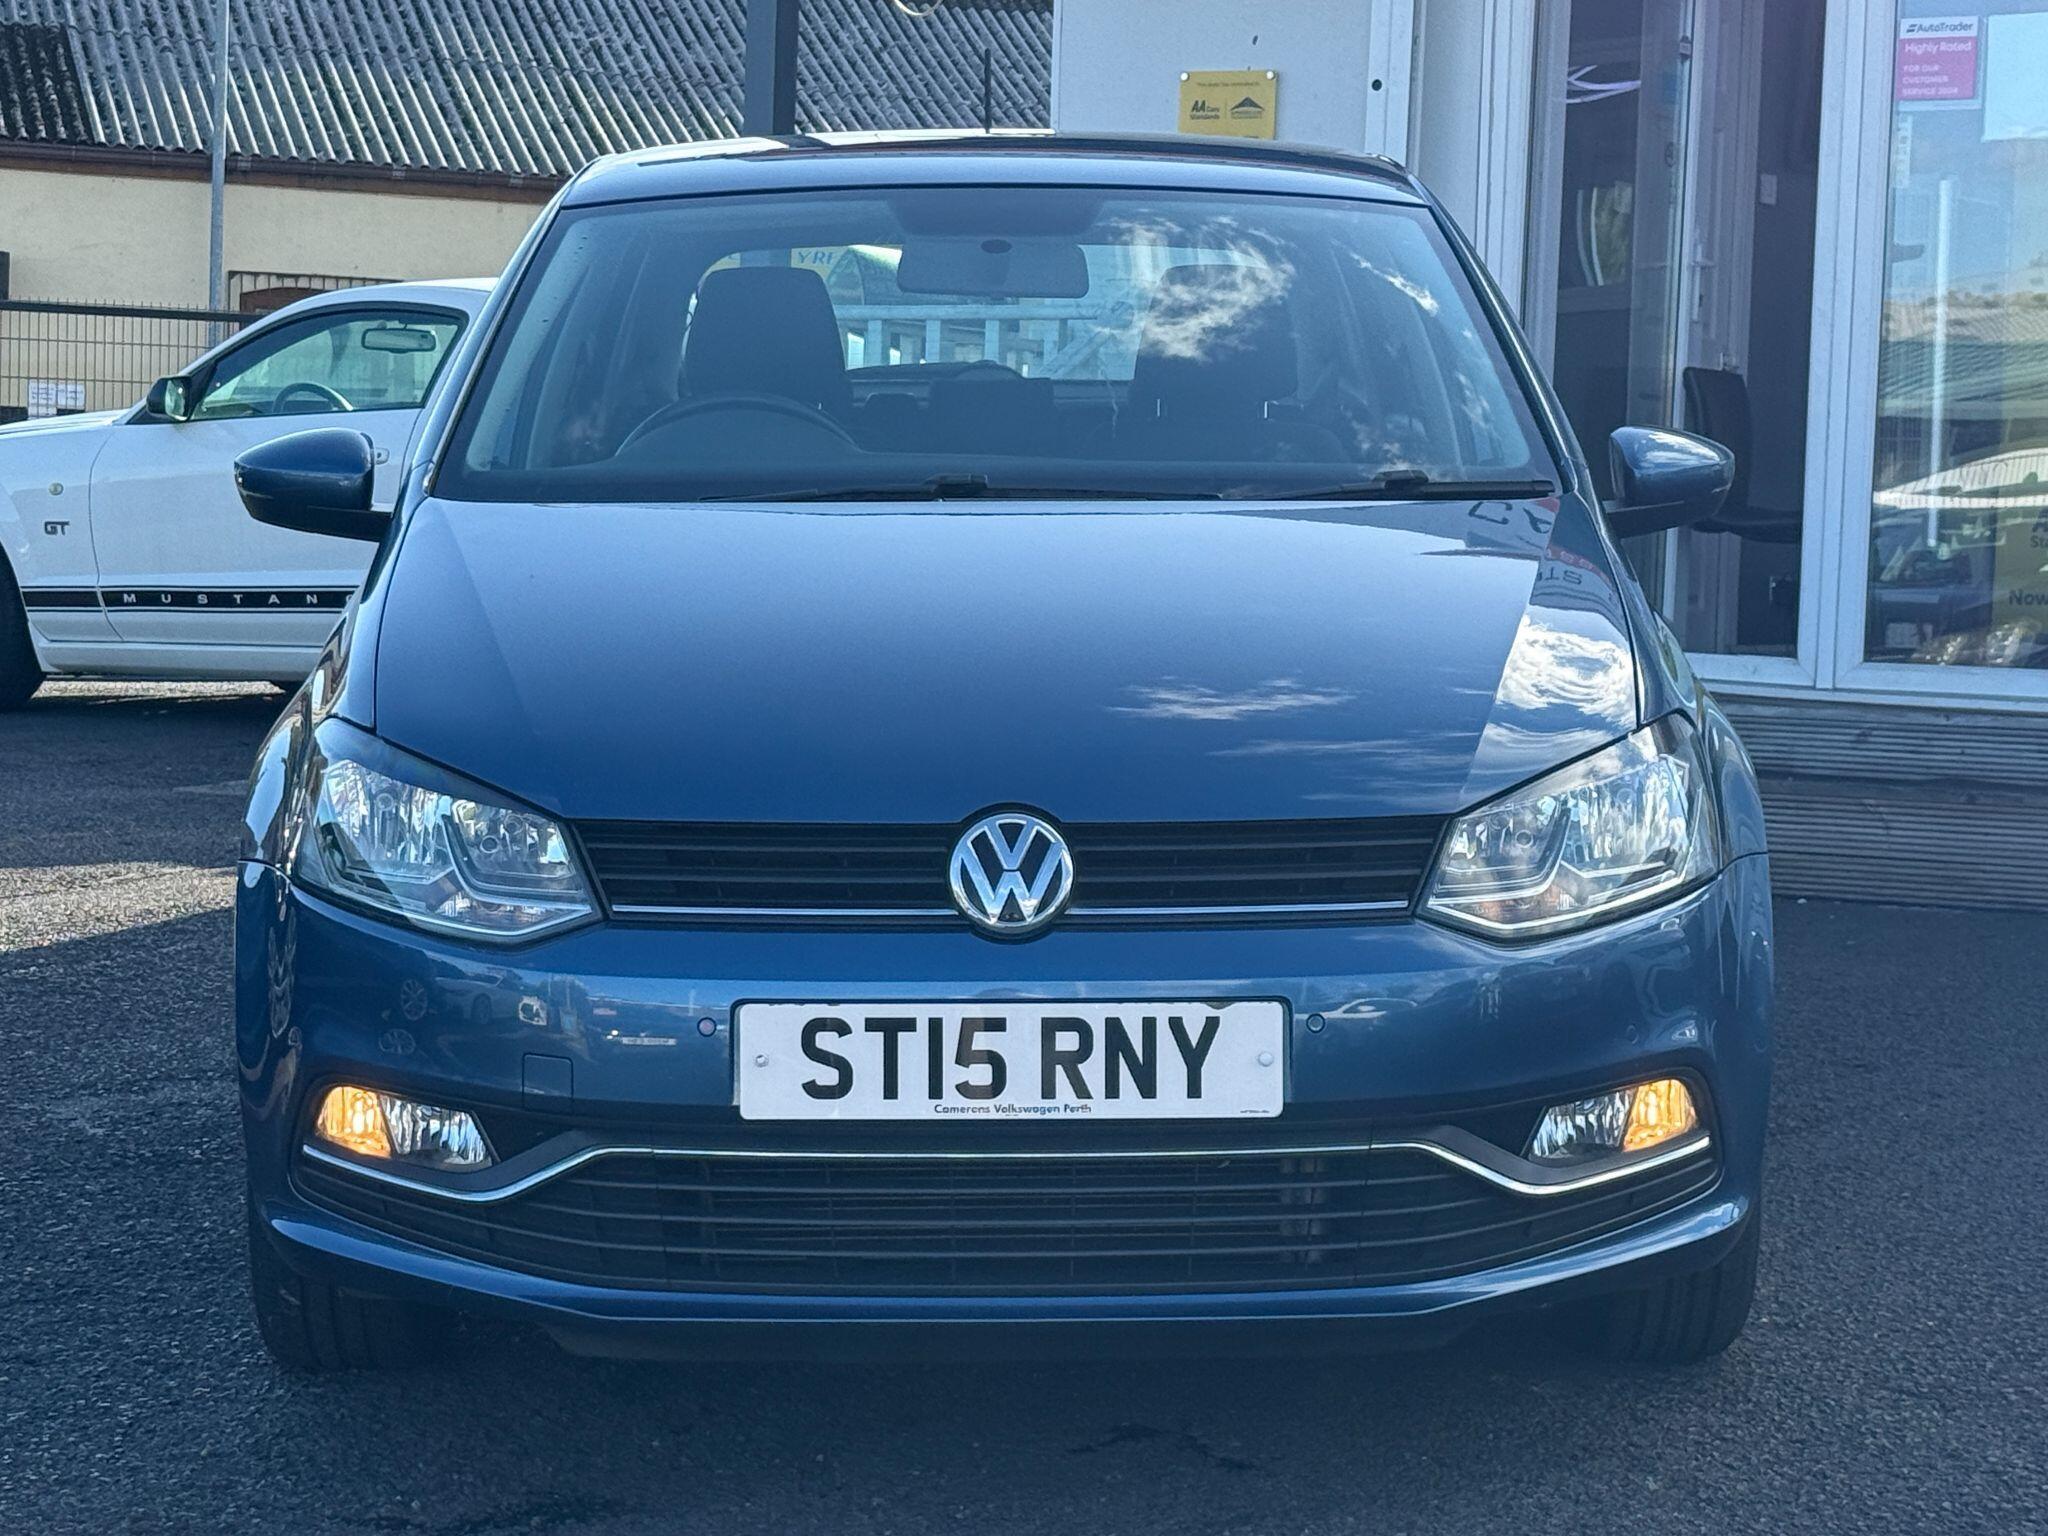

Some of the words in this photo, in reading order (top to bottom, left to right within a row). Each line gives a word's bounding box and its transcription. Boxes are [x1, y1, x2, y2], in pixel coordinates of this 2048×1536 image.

[1917, 22, 1973, 33] AutoTrader
[1904, 43, 1938, 55] Highly
[1939, 42, 1972, 52] Rated
[44, 521, 70, 535] GT
[801, 1017, 1007, 1100] ST15
[1041, 1016, 1221, 1100] RNY
[934, 1103, 991, 1114] Camerons
[994, 1103, 1061, 1116] Volkswagen
[1063, 1103, 1092, 1114] Perth
